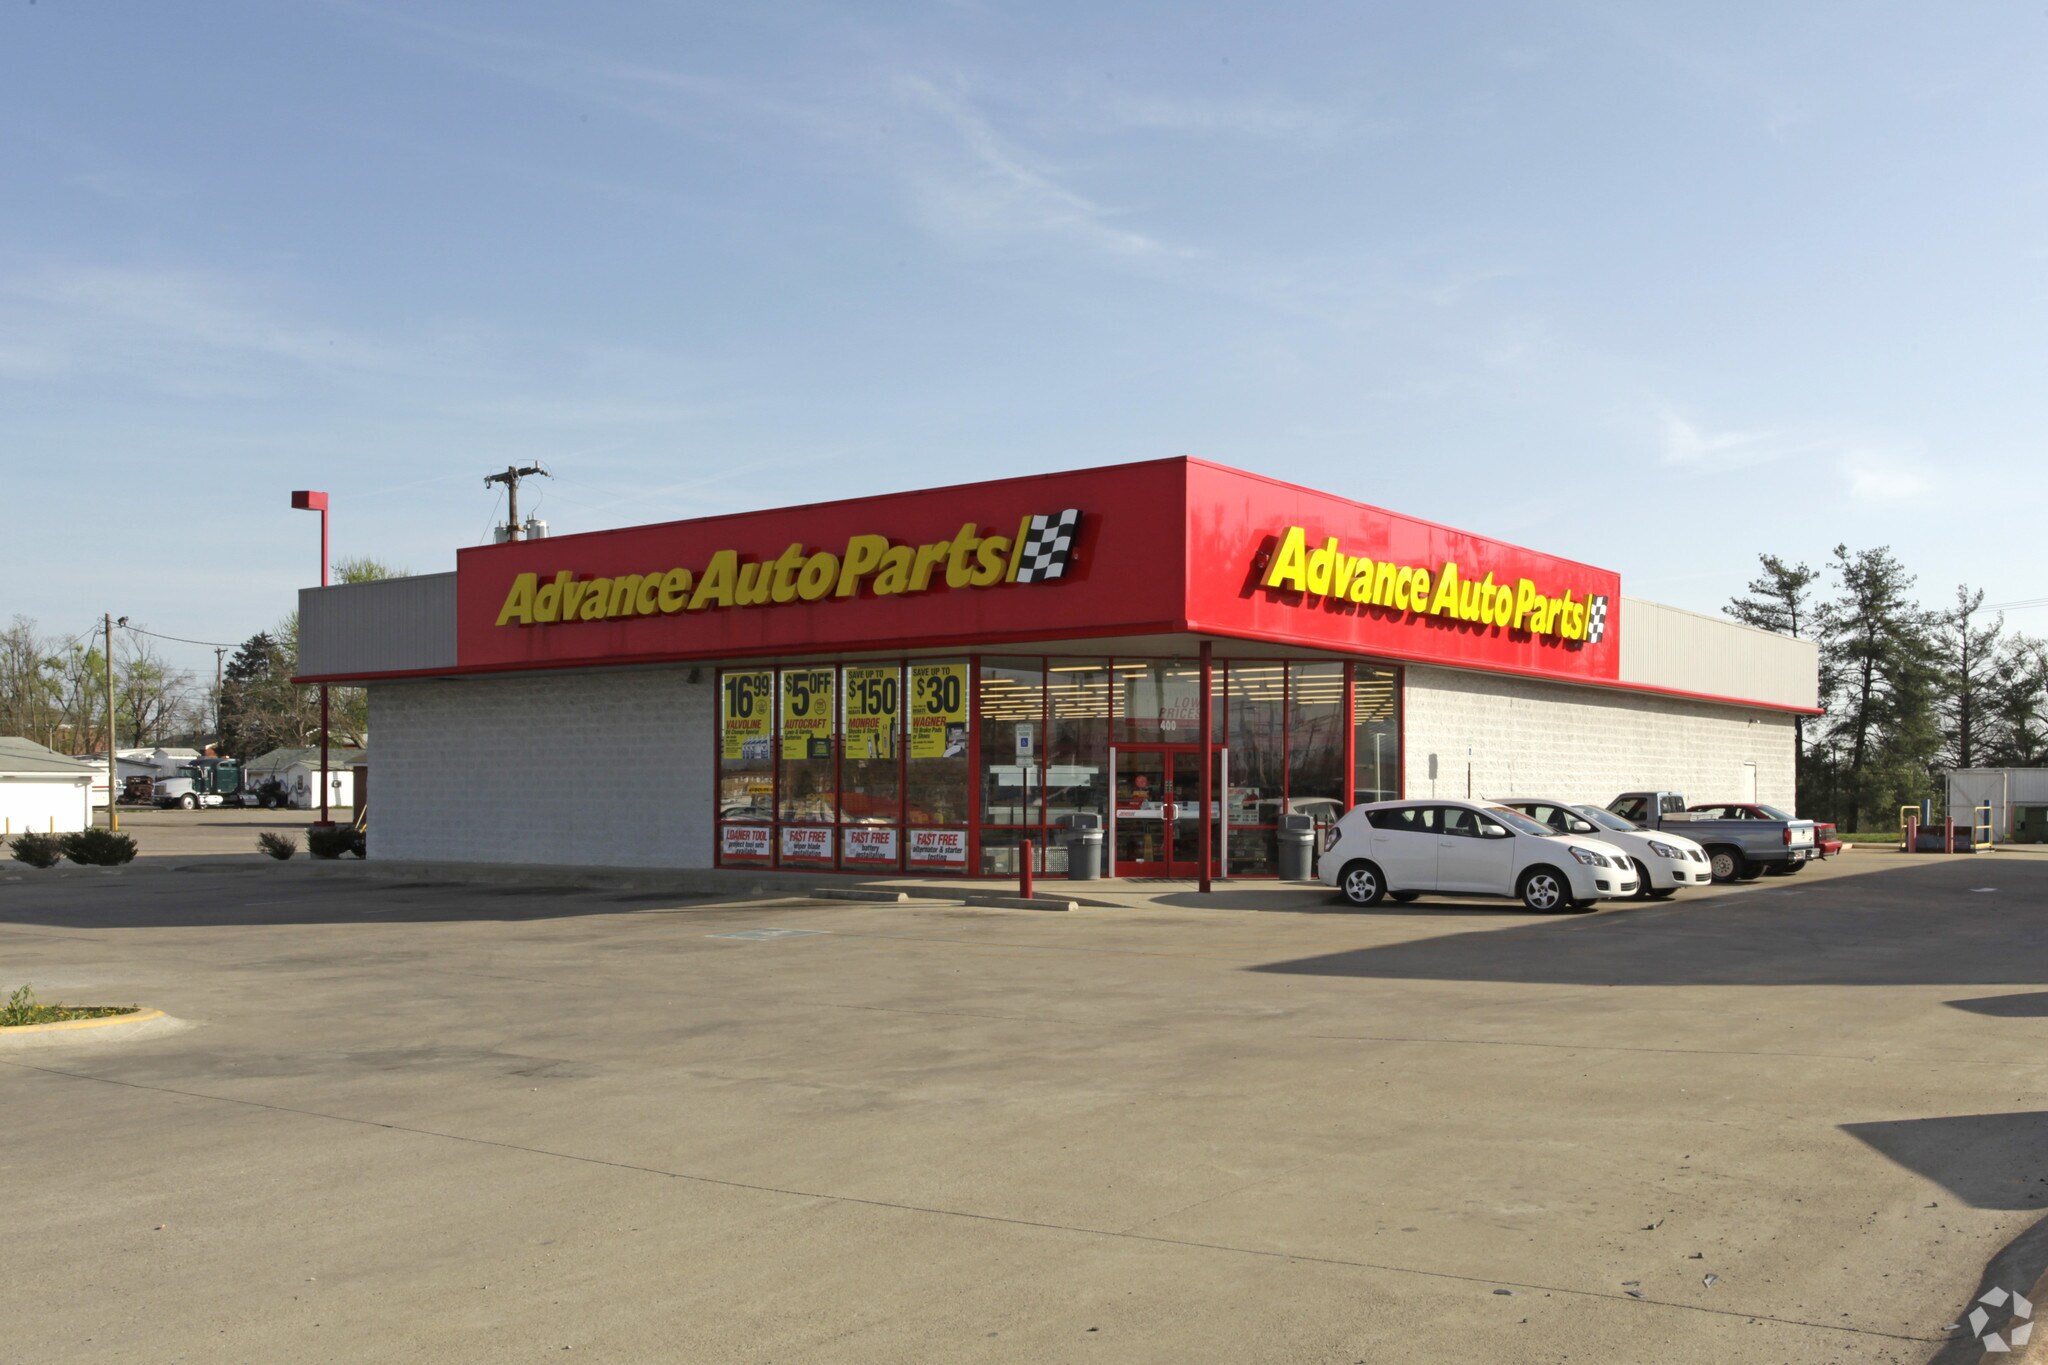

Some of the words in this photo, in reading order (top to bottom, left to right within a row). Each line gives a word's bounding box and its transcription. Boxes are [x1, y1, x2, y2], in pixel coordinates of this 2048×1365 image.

[494, 567, 693, 626] Advance
[687, 542, 837, 610] Auto
[835, 522, 1015, 597] Parts
[1262, 526, 1431, 613] Advance
[1430, 562, 1512, 627] Auto
[1511, 578, 1584, 640] Parts
[848, 670, 865, 679] SAVE
[865, 670, 874, 678] UP
[876, 670, 884, 678] TO
[912, 668, 929, 676] SAVE
[931, 667, 940, 676] UP
[942, 666, 951, 675] TO
[809, 672, 832, 694] OFF
[848, 678, 897, 715] $150
[916, 675, 960, 714] $30
[726, 720, 762, 729] VALVOLINE
[784, 718, 827, 729] AUTOCRAFT
[848, 718, 880, 728] MONROE
[912, 716, 946, 727] WAGNER
[1160, 720, 1176, 730] 400
[726, 830, 750, 840] LOANER
[752, 830, 768, 841] TOOL
[789, 830, 807, 842] FAST
[808, 831, 827, 842] FREE
[851, 832, 870, 844] FAST
[871, 832, 890, 844] FREE
[916, 833, 936, 845] FAST
[938, 834, 958, 846] FREE
[862, 844, 880, 854] battery
[928, 853, 948, 861] testing
